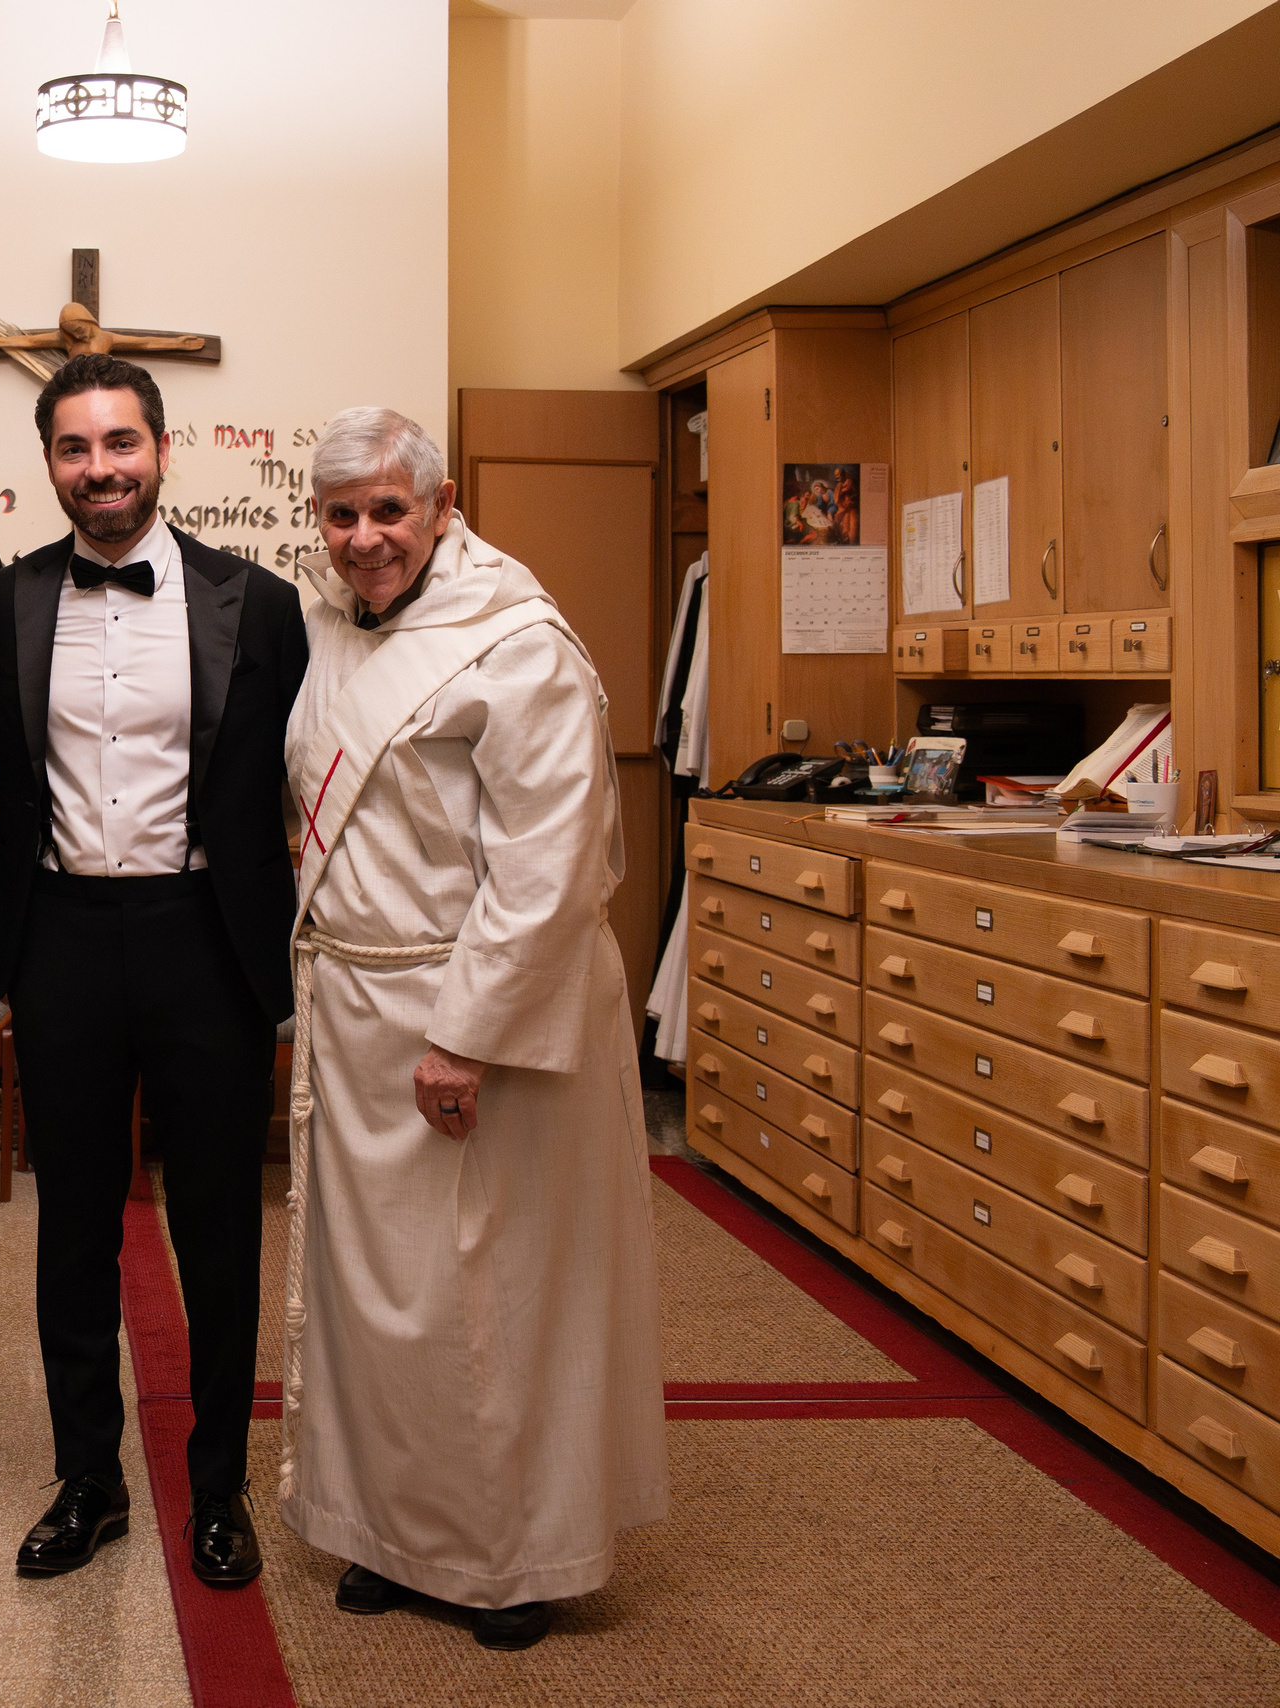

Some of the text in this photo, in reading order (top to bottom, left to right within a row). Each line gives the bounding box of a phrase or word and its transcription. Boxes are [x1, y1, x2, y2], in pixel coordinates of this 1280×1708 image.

[171, 422, 327, 459] nd Mary sa
[290, 497, 318, 529] th
